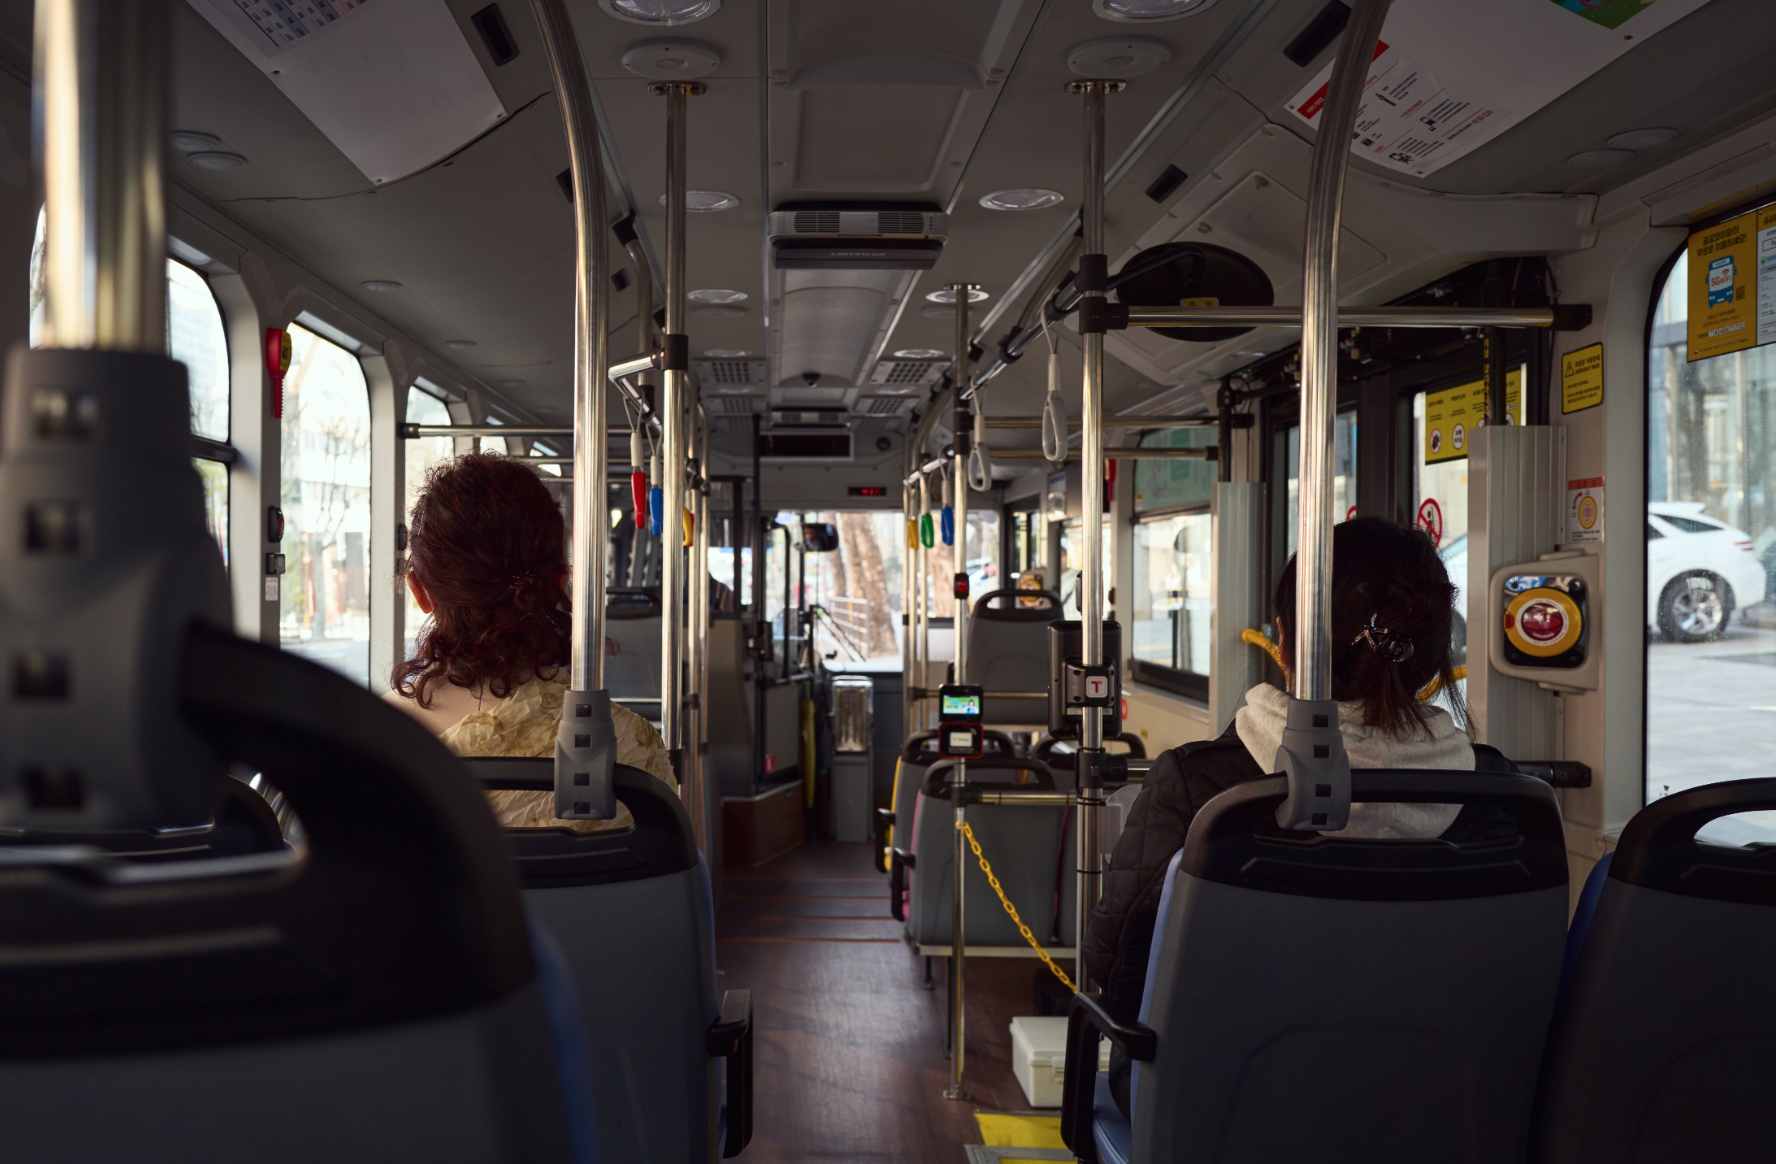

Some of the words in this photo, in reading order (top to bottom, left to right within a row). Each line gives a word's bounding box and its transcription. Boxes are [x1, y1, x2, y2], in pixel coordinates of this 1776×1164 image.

[1697, 244, 1714, 257] 무료로
[1715, 233, 1747, 251] 이용하세요!
[1702, 225, 1739, 246] 공공와이파이
